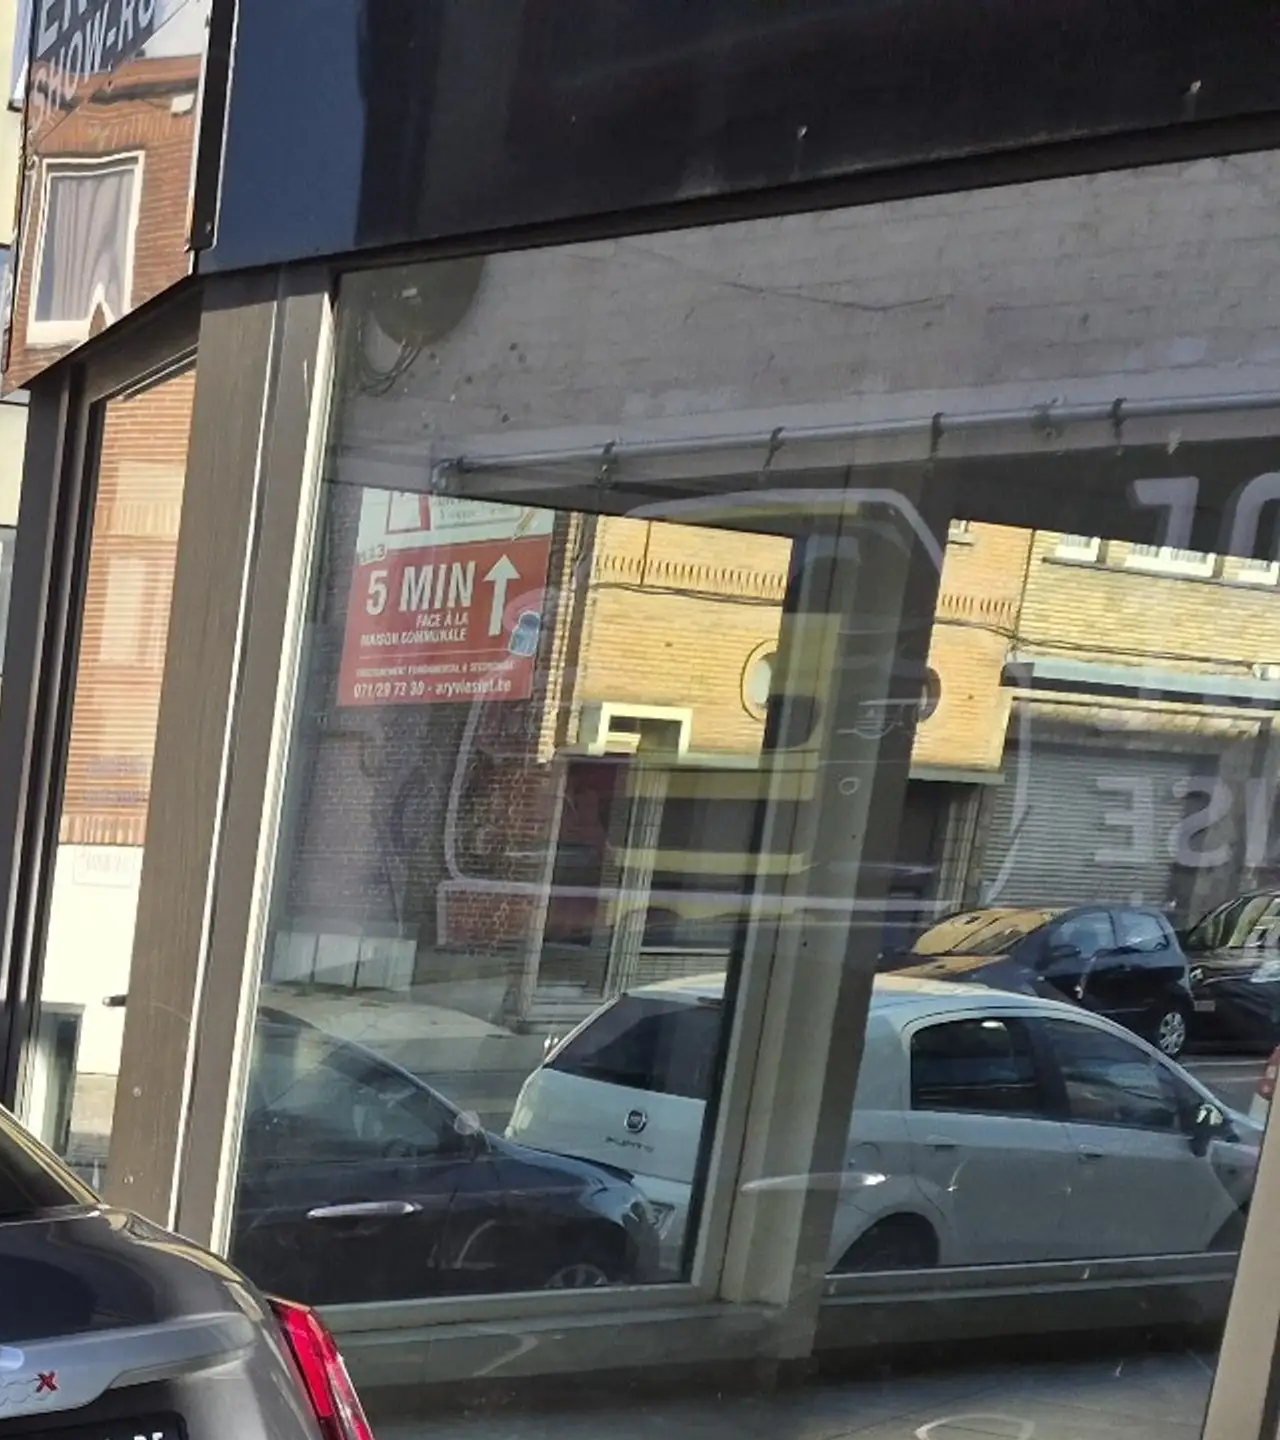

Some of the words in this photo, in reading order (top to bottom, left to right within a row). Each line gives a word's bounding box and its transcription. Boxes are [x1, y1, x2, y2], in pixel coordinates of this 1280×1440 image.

[366, 570, 388, 616] 5
[398, 560, 476, 612] MIN
[416, 613, 441, 629] FACE
[455, 611, 469, 626] LA
